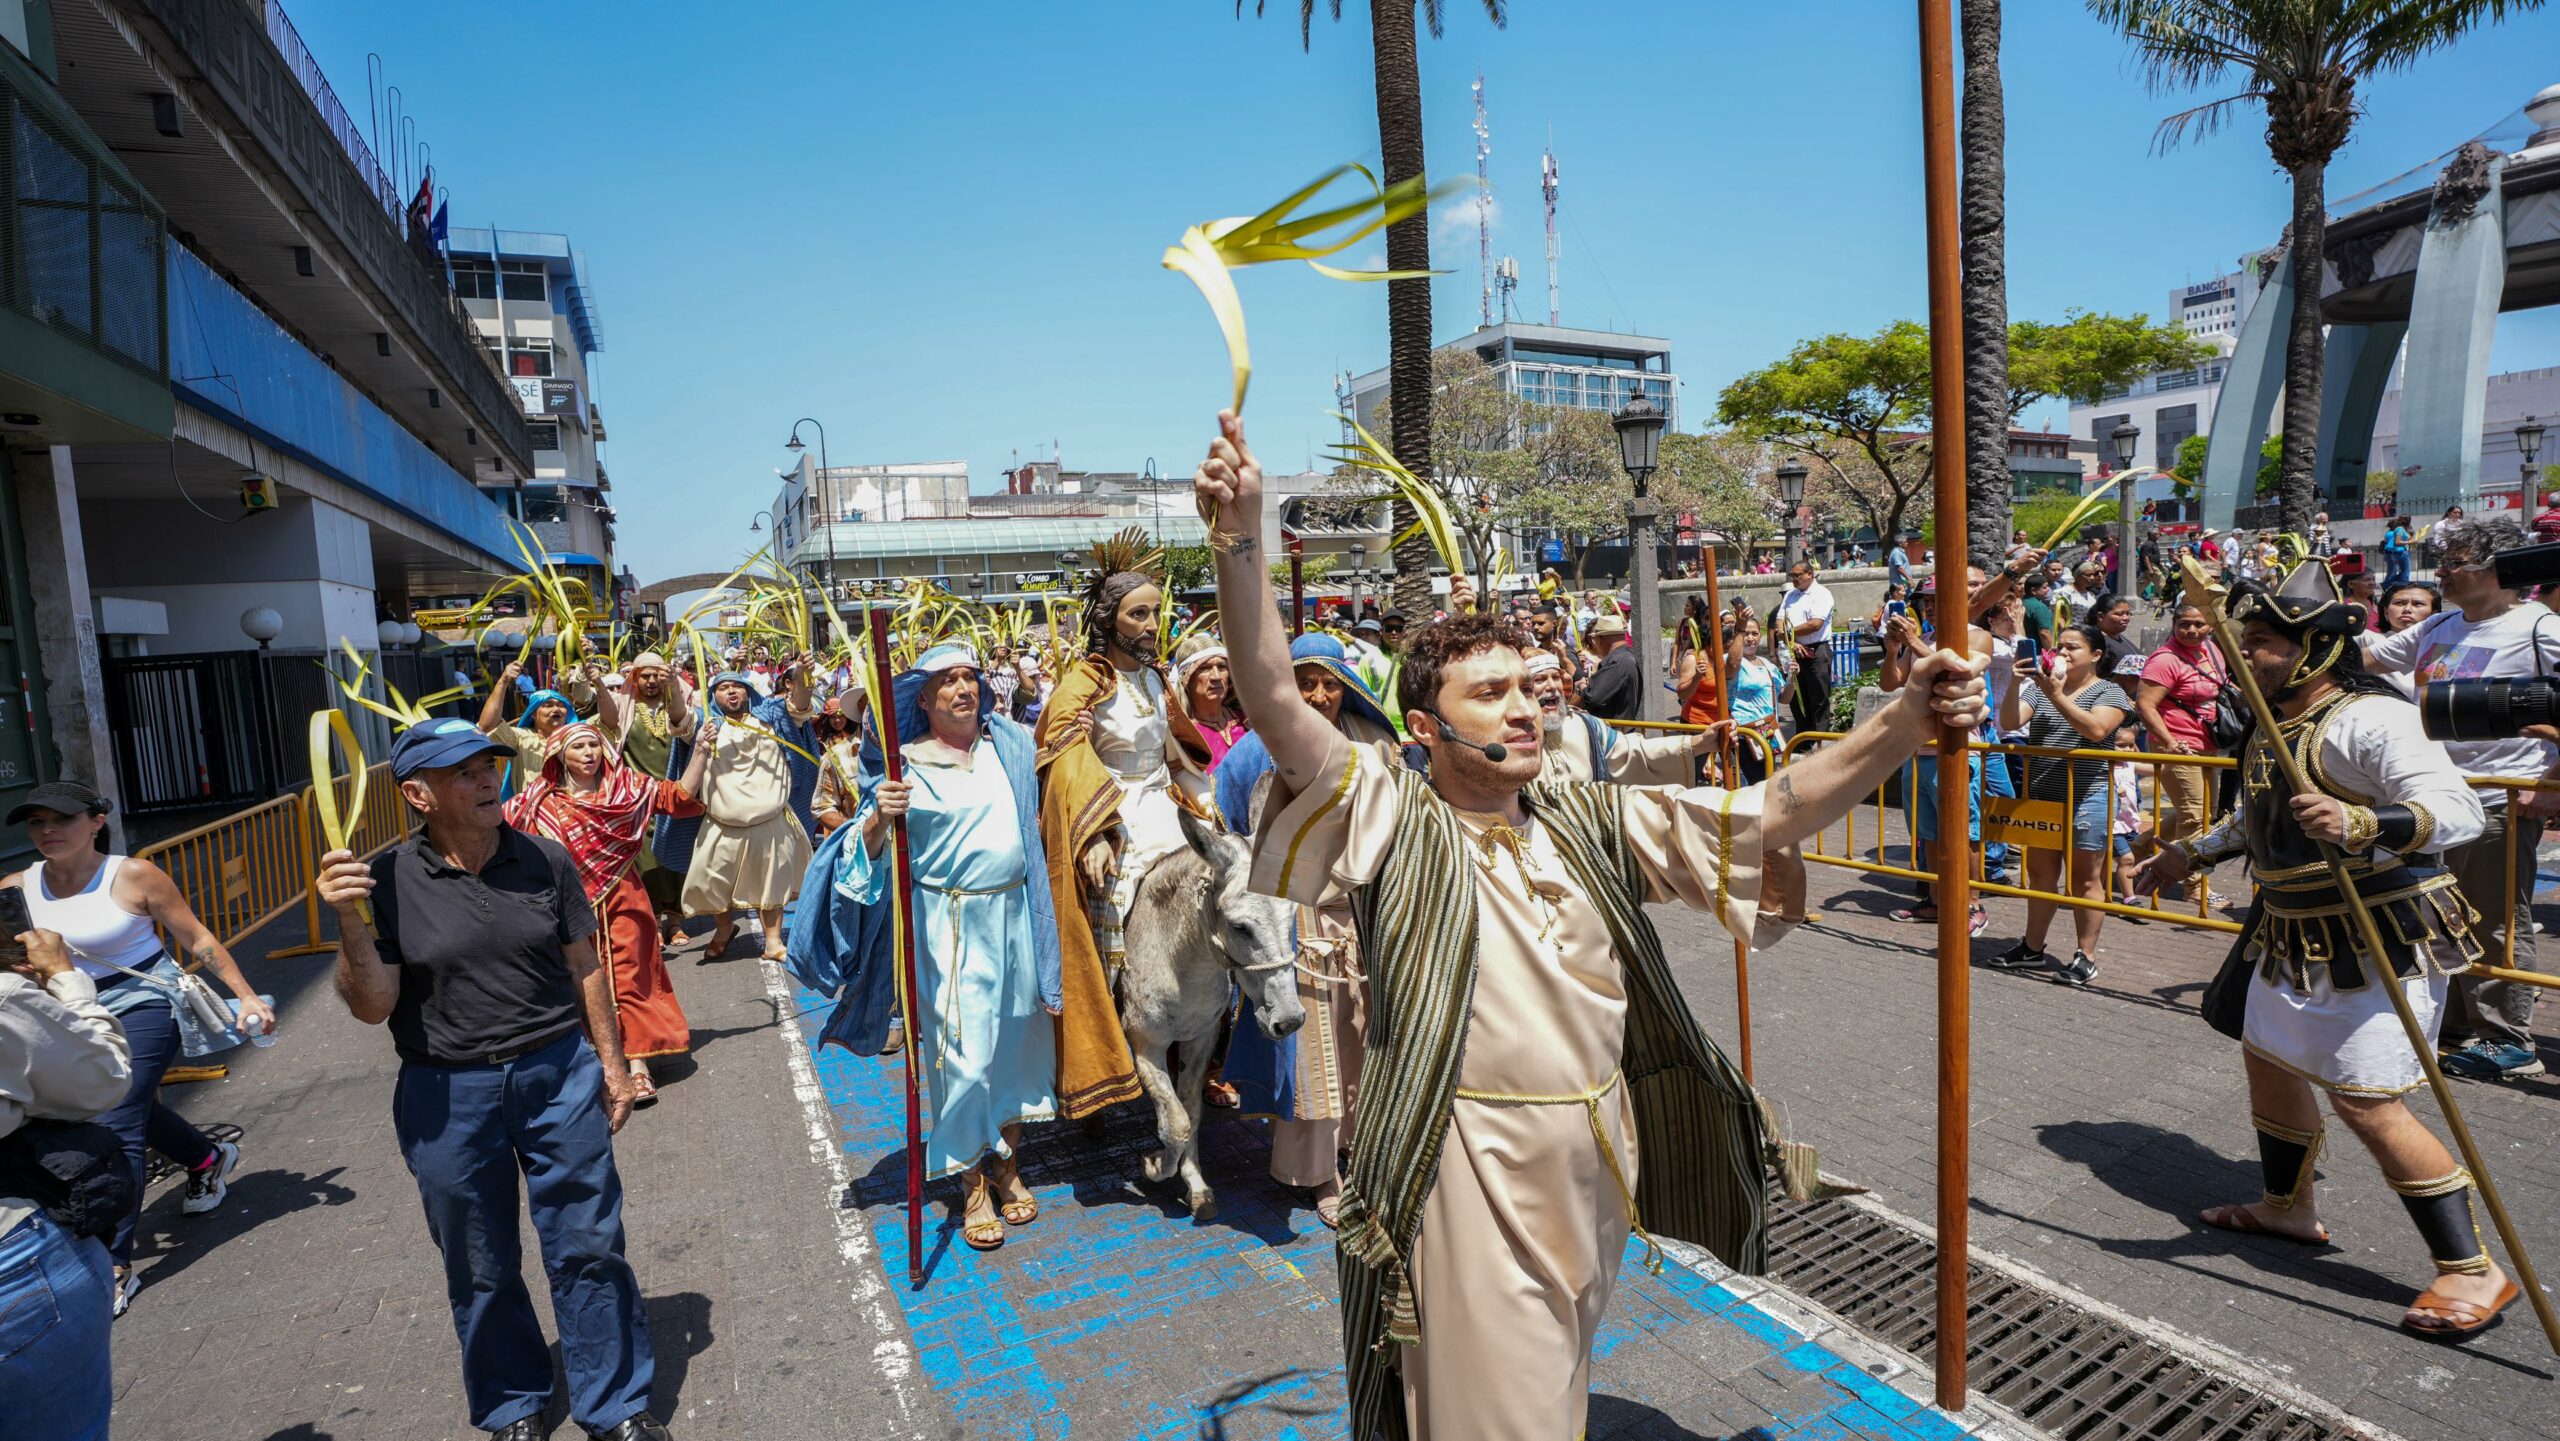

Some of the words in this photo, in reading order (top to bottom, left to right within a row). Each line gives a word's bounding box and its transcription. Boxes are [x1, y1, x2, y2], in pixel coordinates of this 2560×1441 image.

[2188, 280, 2226, 296] BANCO
[543, 382, 574, 390] GIMNASIO
[2000, 815, 2062, 832] RAHSO
